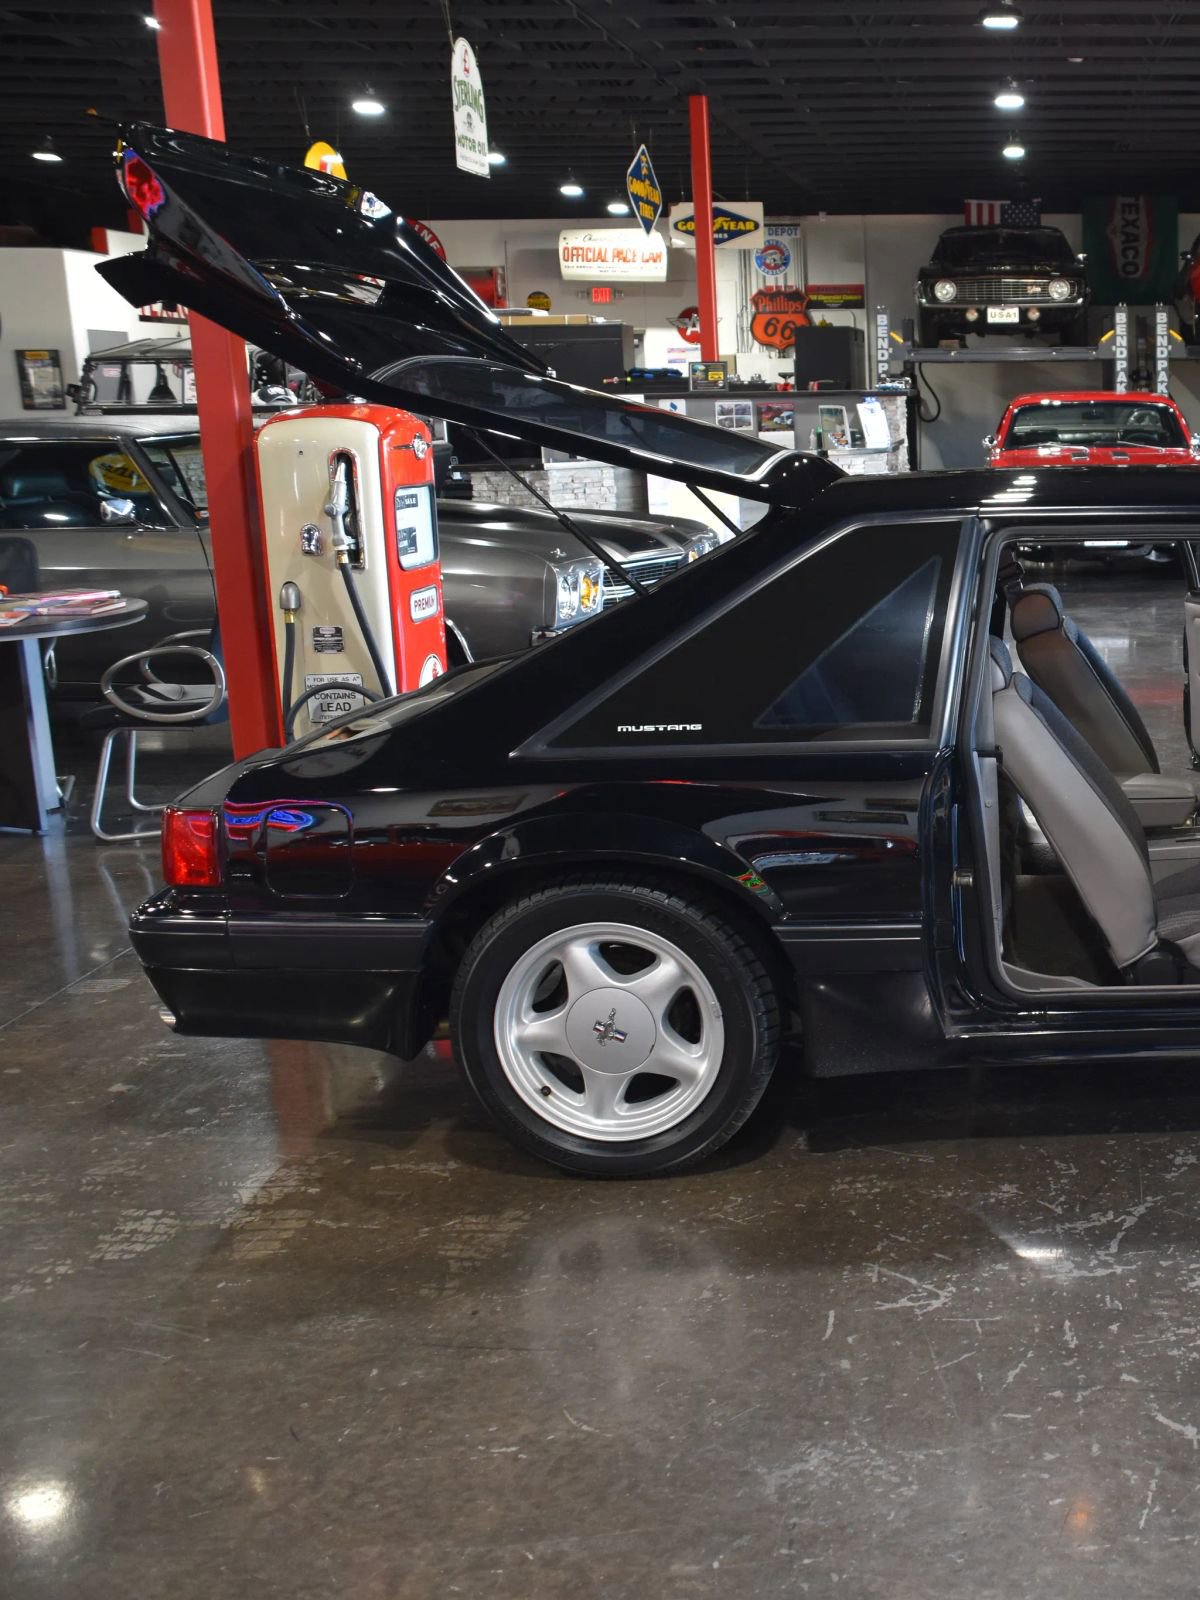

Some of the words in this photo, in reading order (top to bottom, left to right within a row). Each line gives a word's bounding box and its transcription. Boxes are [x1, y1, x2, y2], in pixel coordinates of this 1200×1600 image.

[453, 74, 484, 124] STERLING
[677, 216, 756, 231] GOYEAR
[767, 227, 799, 237] DEPOT
[562, 246, 608, 263] OFFICIAL
[756, 294, 801, 314] Phillips
[764, 317, 798, 341] 66
[876, 314, 889, 377] BENDP
[1116, 312, 1127, 395] BENDPAK
[1156, 312, 1168, 395] BENDPAK
[313, 692, 356, 700] CONTAINS
[320, 702, 352, 712] LEAD
[617, 723, 702, 732] MUSTANG
